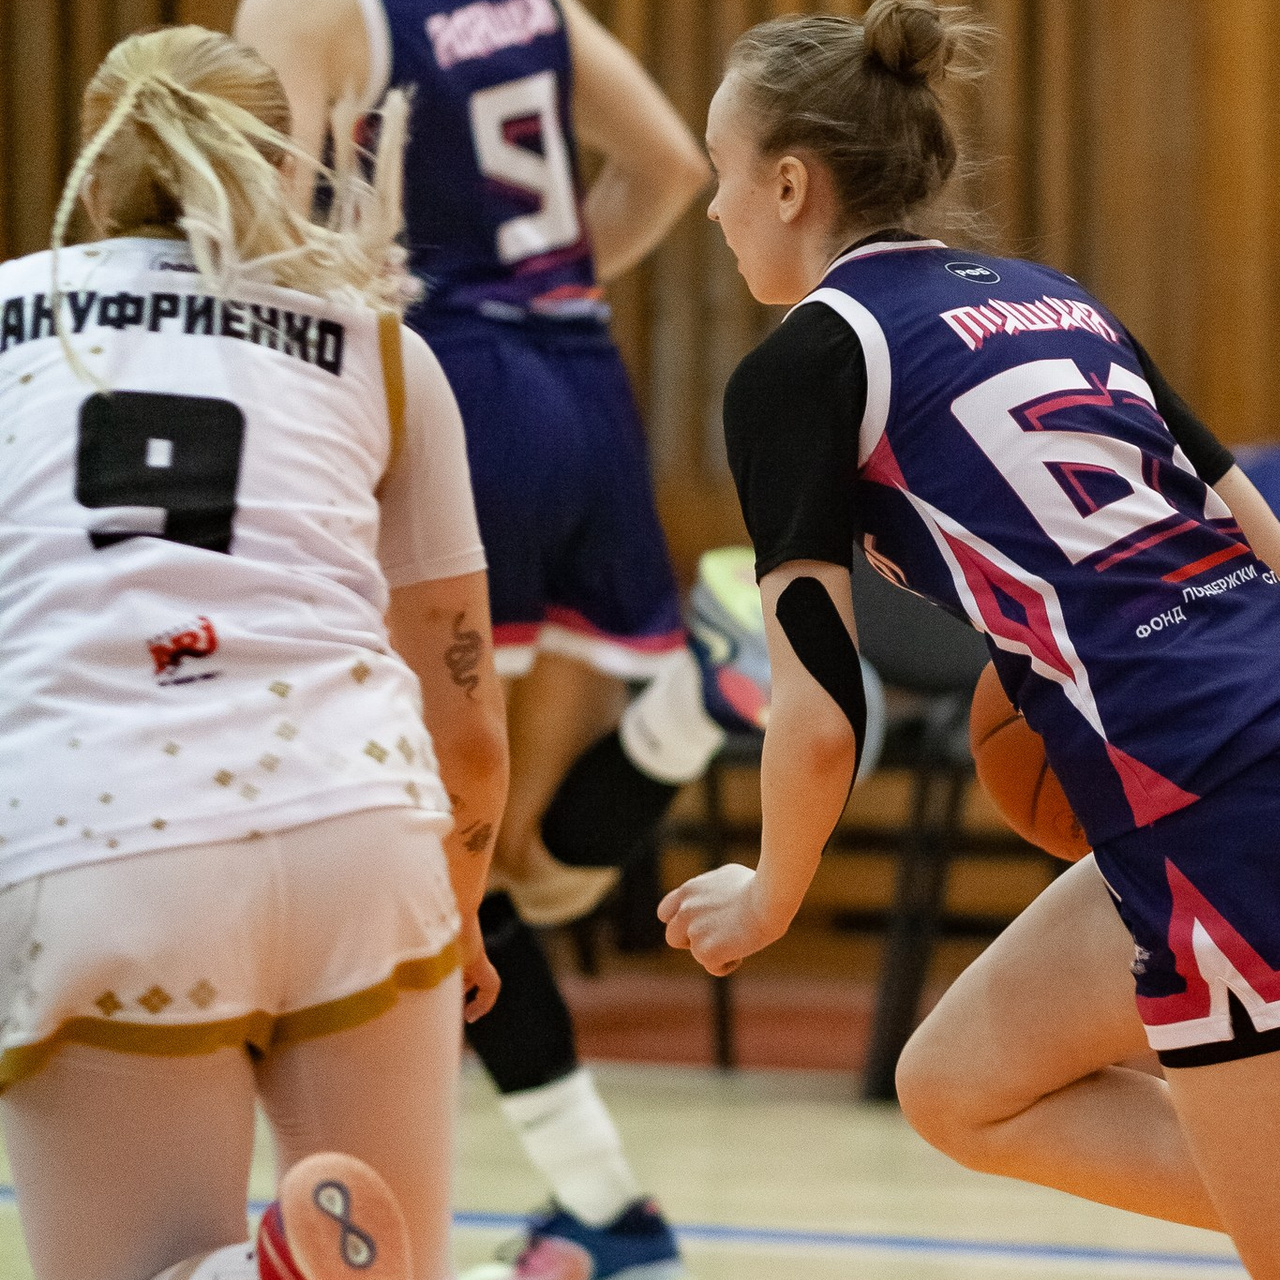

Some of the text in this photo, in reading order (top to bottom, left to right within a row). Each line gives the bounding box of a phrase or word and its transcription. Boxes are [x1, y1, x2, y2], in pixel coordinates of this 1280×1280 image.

[468, 70, 580, 264] 9
[0, 291, 345, 376] АНУФРИЕНКО
[74, 390, 246, 555] 9
[1135, 605, 1188, 639] ФОНД
